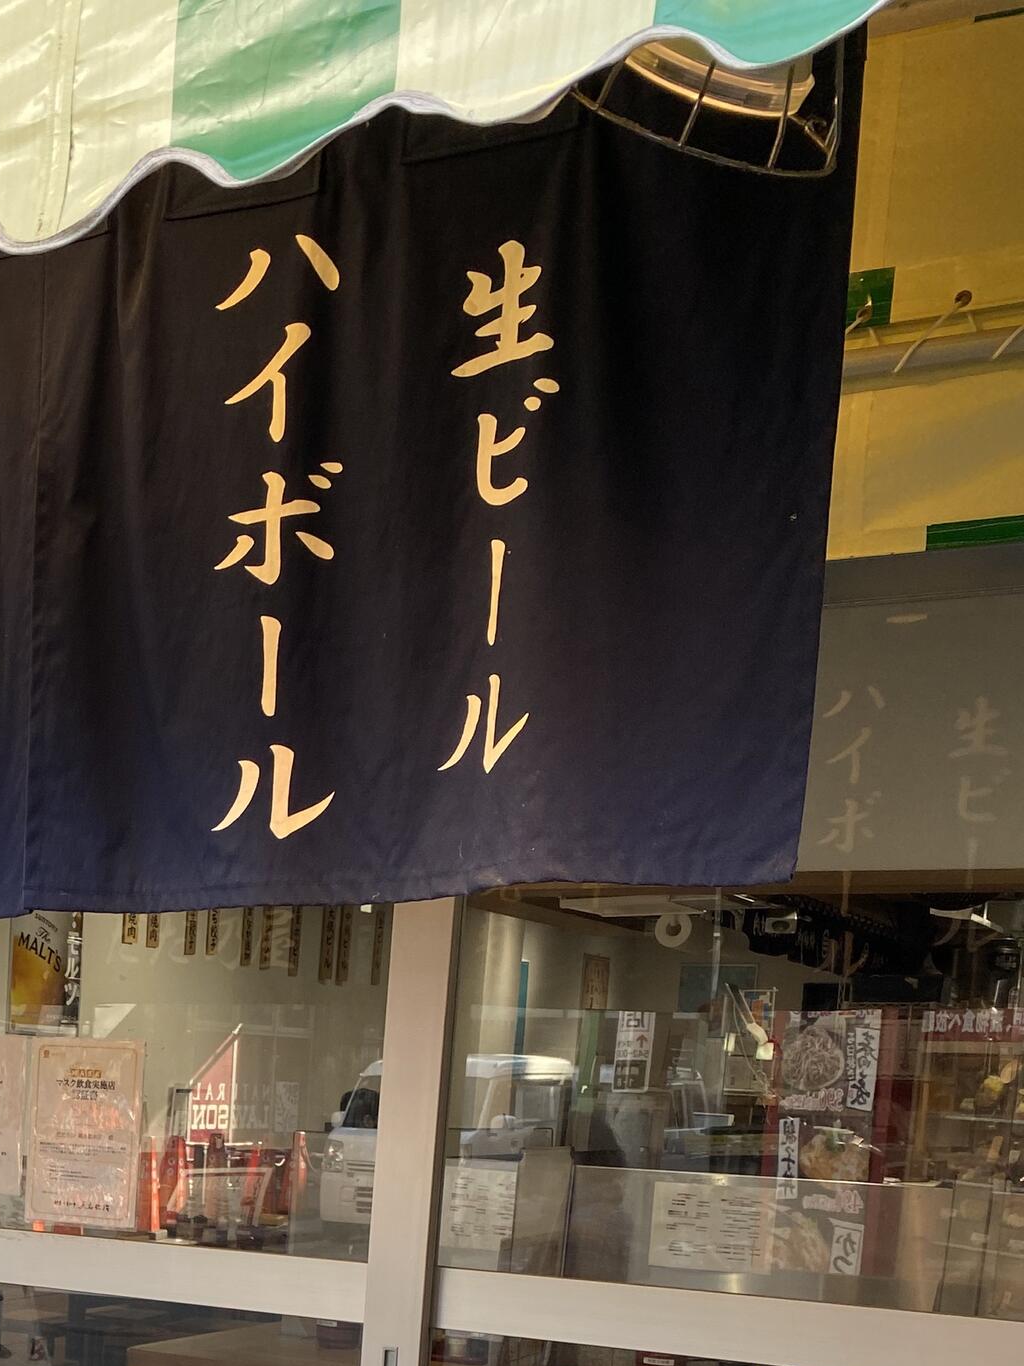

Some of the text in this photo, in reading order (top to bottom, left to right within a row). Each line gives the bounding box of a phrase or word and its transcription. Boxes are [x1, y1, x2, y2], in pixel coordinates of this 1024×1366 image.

[210, 233, 345, 841] ハイボール
[437, 240, 561, 775] 生ビール
[36, 927, 50, 941] The
[56, 1078, 116, 1091] マスク飲食実施店
